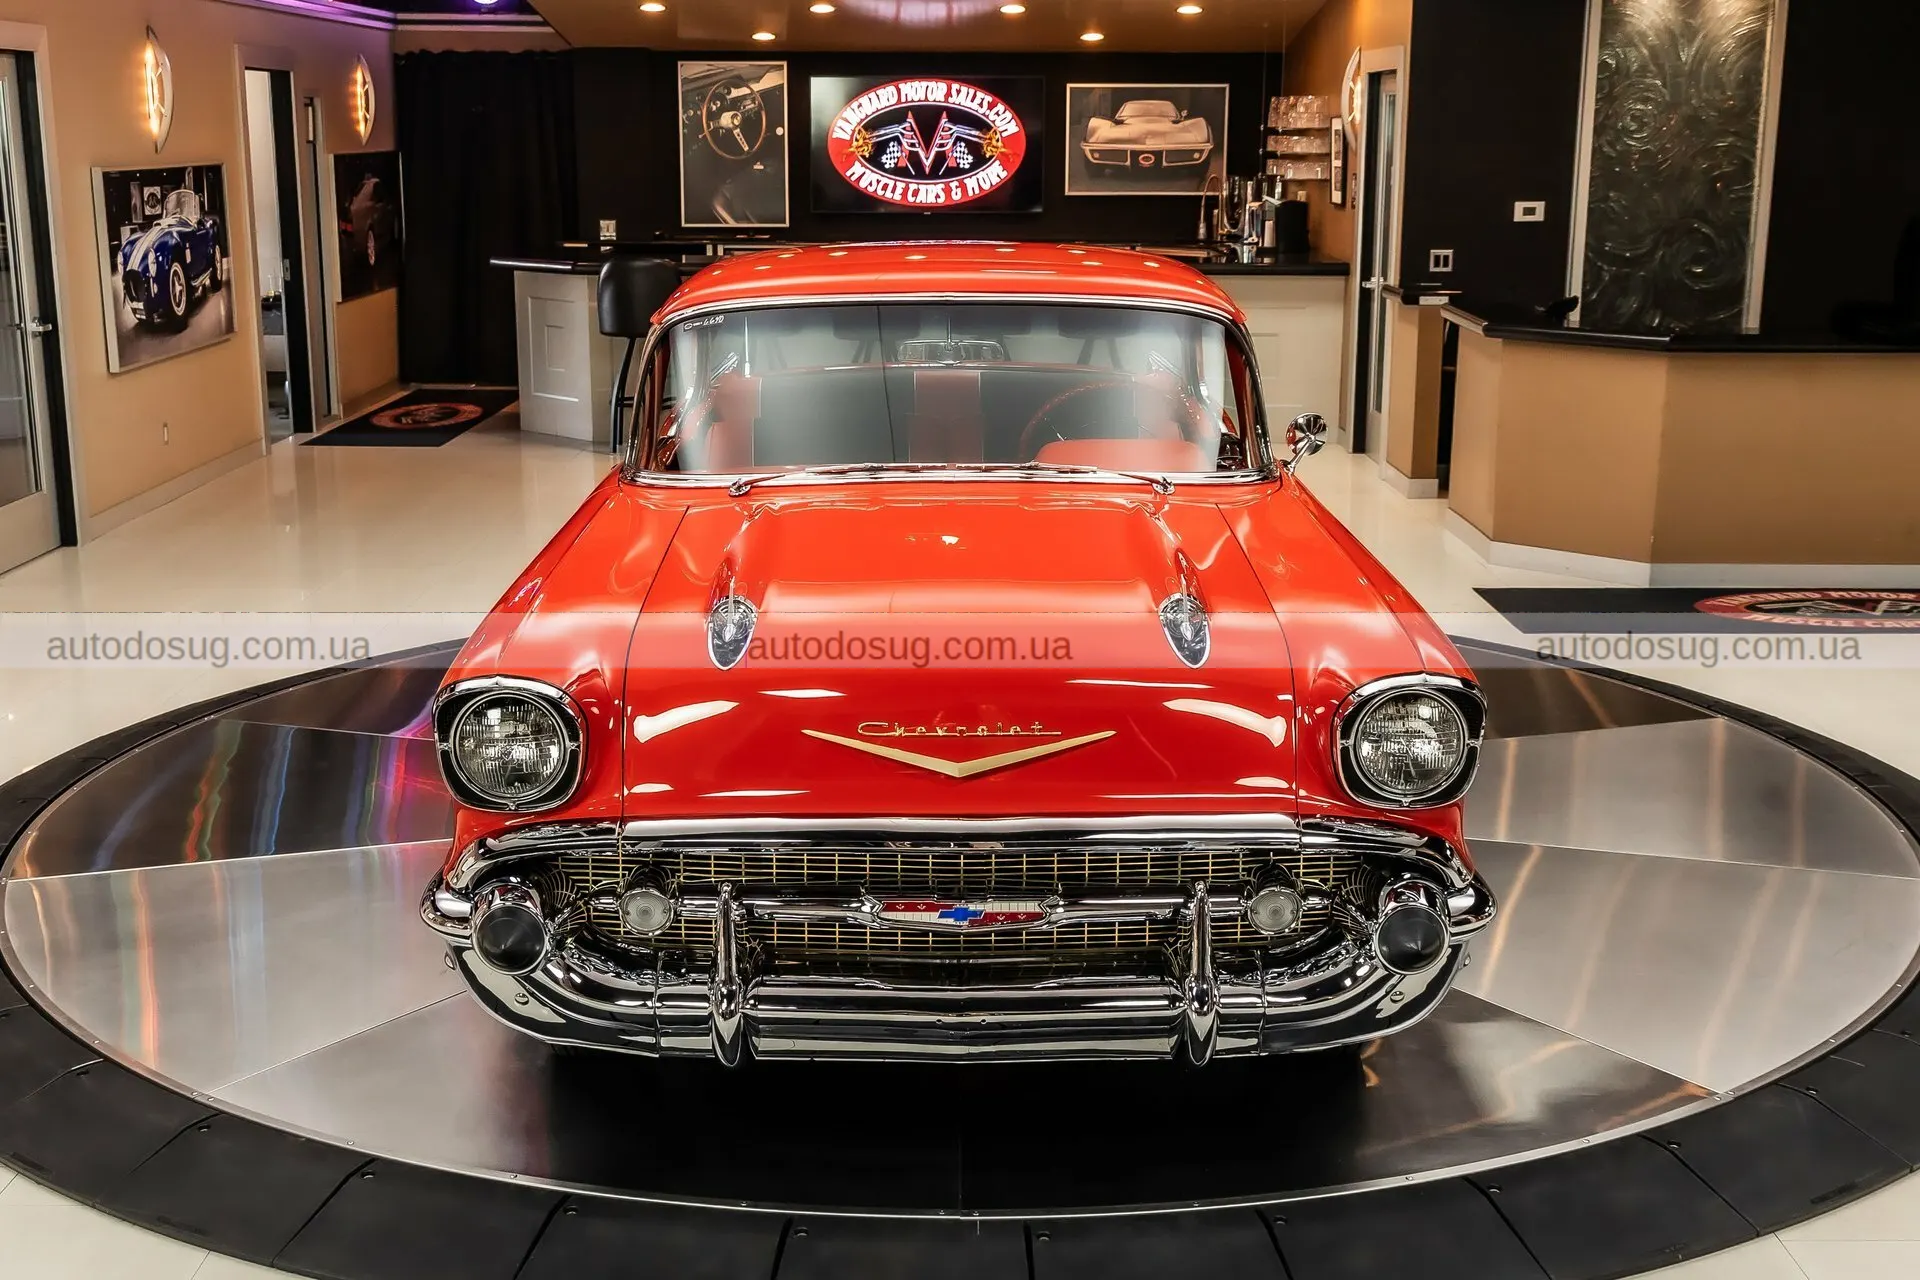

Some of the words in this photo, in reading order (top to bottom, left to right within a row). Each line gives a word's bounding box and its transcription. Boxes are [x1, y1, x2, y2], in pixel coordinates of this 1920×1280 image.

[832, 86, 898, 140] VANGUARD
[899, 81, 948, 102] MOTOR
[949, 83, 1020, 138] SALES.COM
[845, 160, 906, 202] MUSCLE
[906, 183, 946, 204] CARS
[950, 184, 962, 201] &
[963, 161, 1009, 197] MORE
[1825, 591, 1917, 599] MOTOR
[857, 721, 1052, 736] Chevrolet
